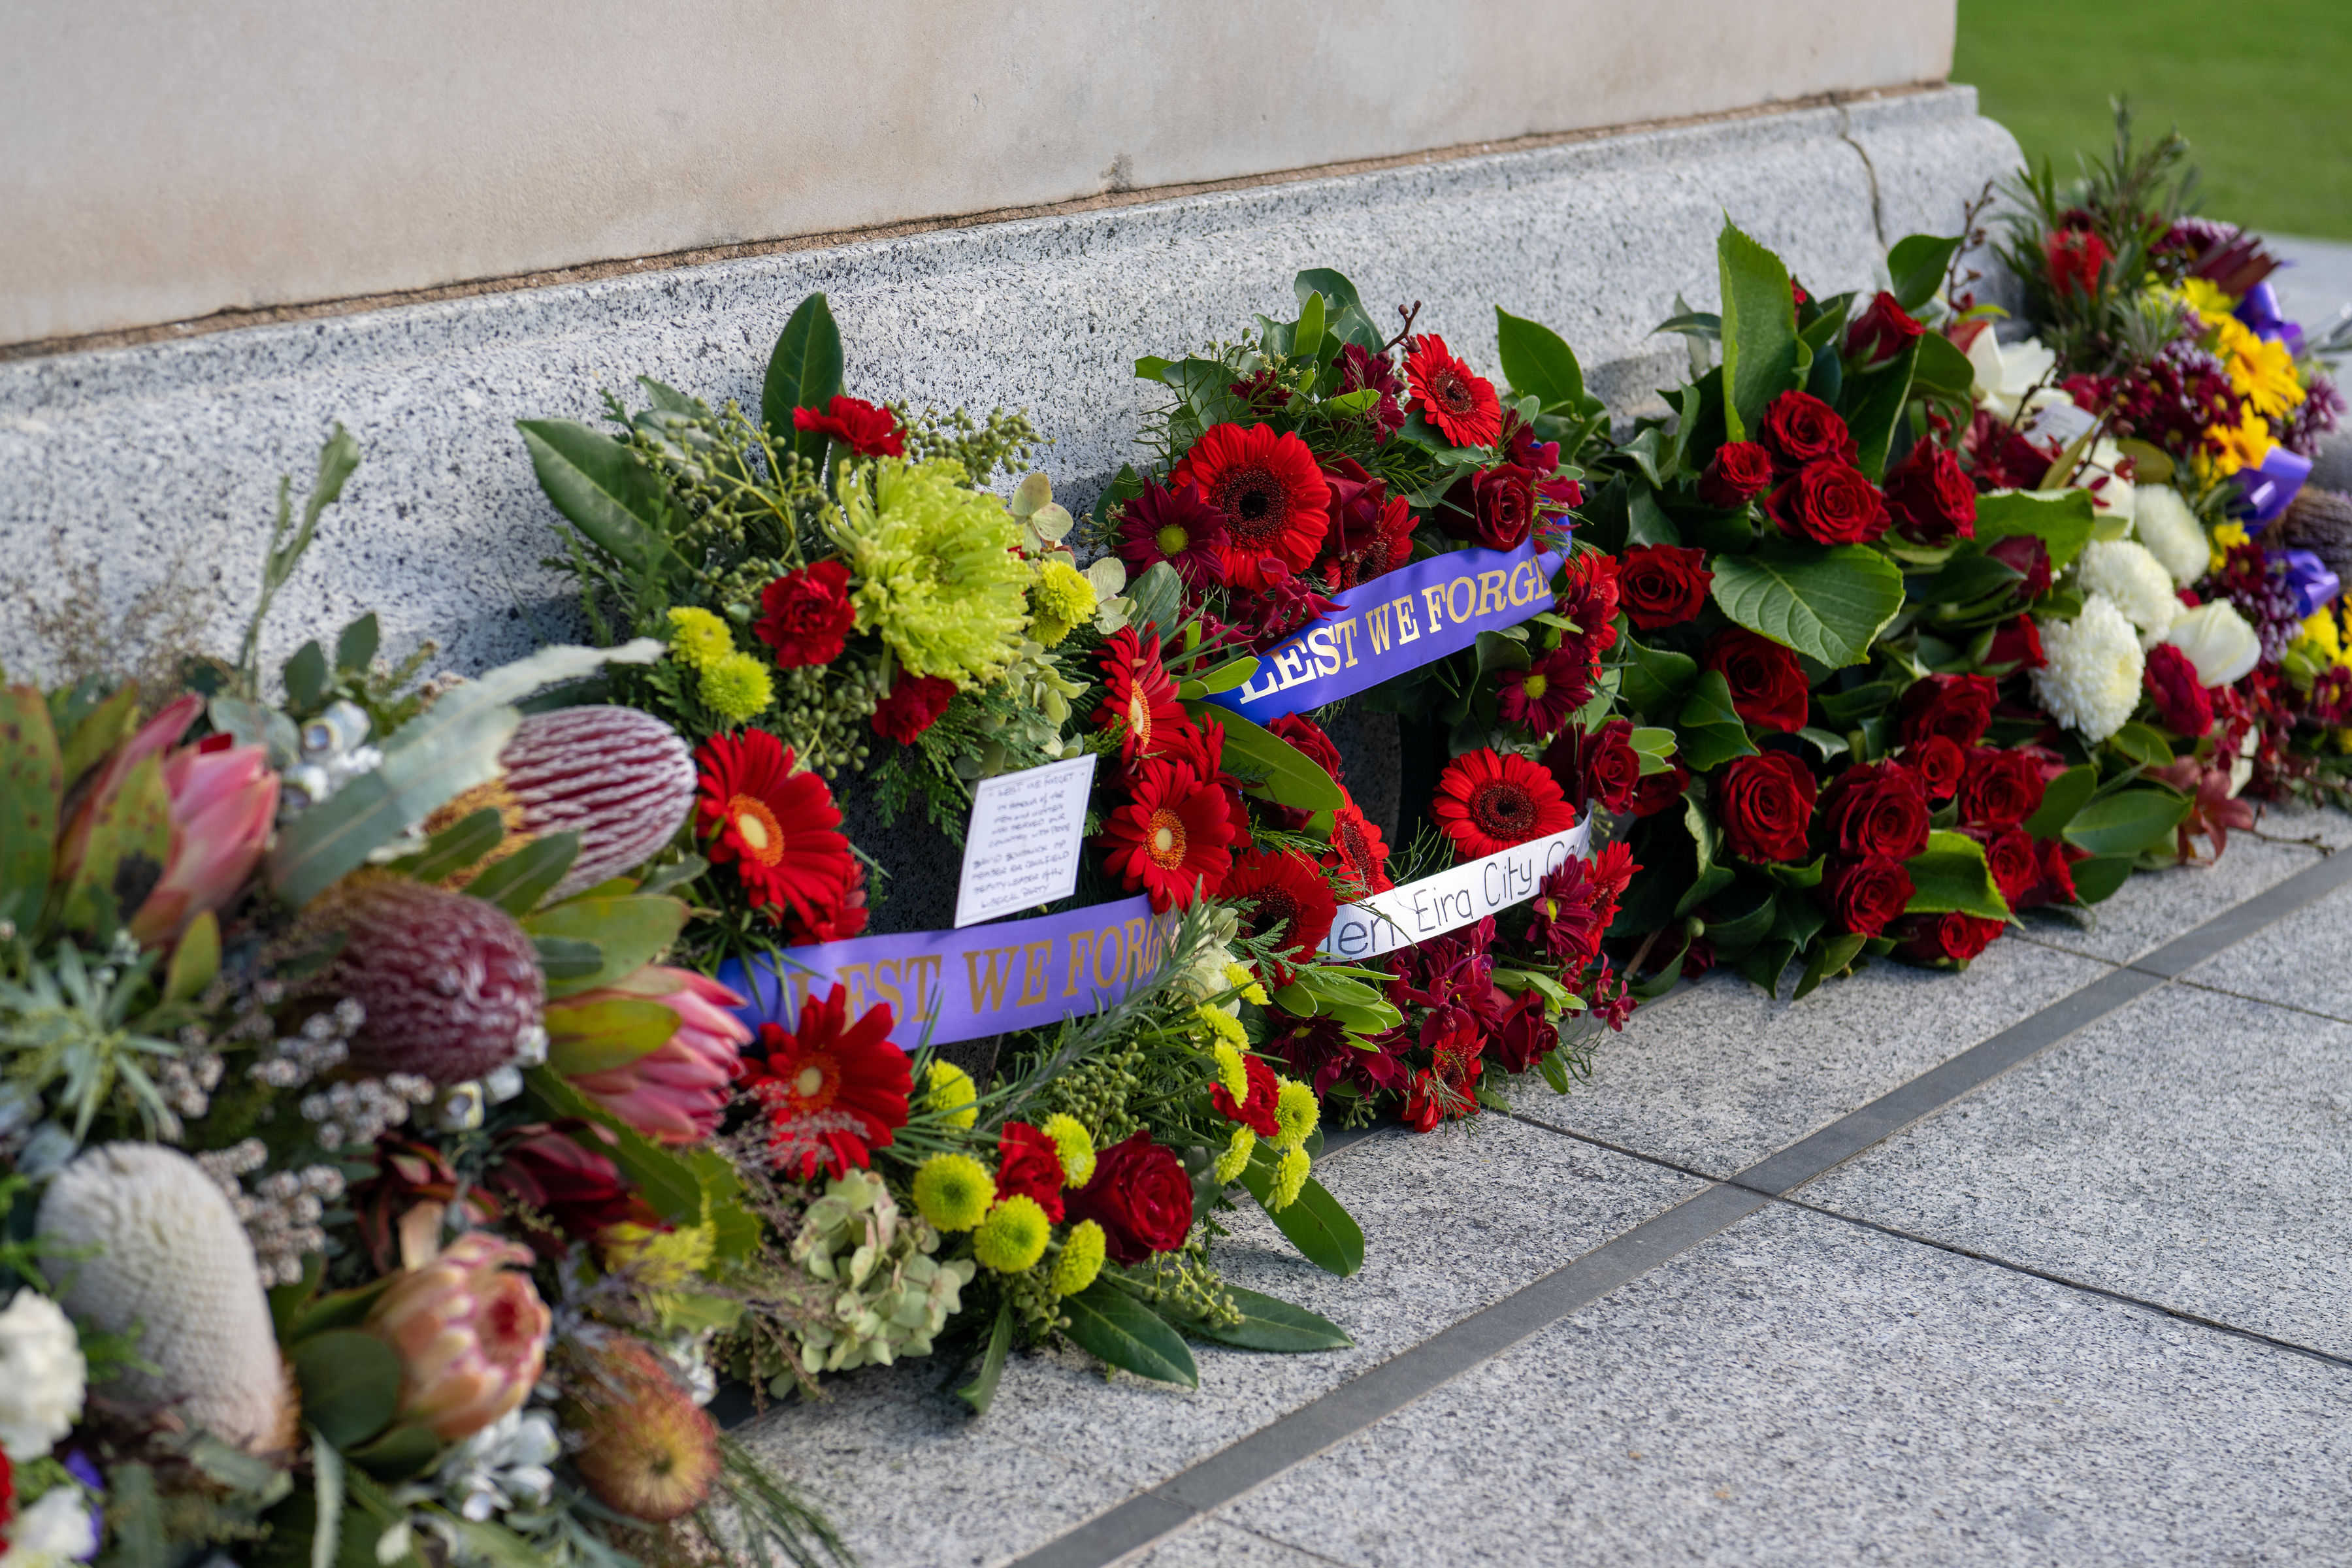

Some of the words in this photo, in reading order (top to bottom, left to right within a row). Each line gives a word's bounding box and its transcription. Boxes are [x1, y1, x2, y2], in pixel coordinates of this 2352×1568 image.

[1239, 617, 1358, 705] LEST
[1365, 594, 1421, 655] WE
[1413, 888, 1475, 933] Eira
[1484, 856, 1532, 907] City
[962, 938, 1053, 1015] WE
